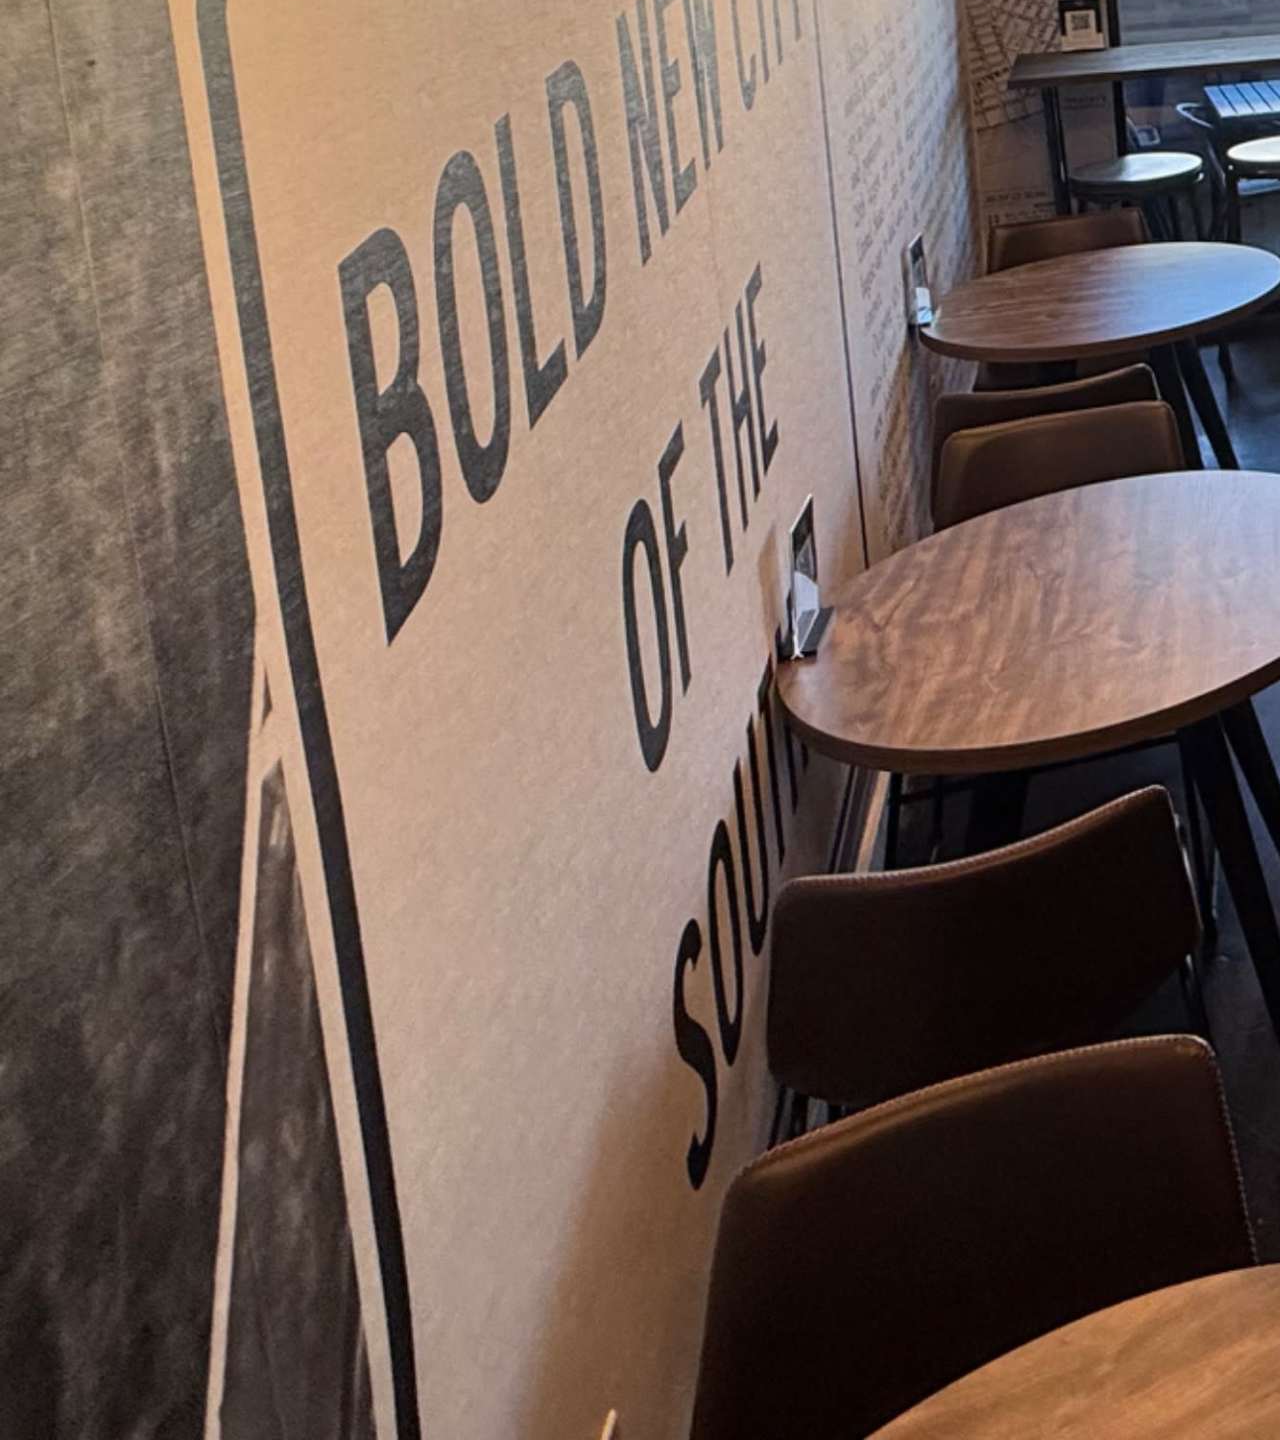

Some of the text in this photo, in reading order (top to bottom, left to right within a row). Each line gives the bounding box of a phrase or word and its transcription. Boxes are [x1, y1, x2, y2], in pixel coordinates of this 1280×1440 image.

[338, 60, 608, 646] BOLD
[620, 261, 780, 772] OF THE
